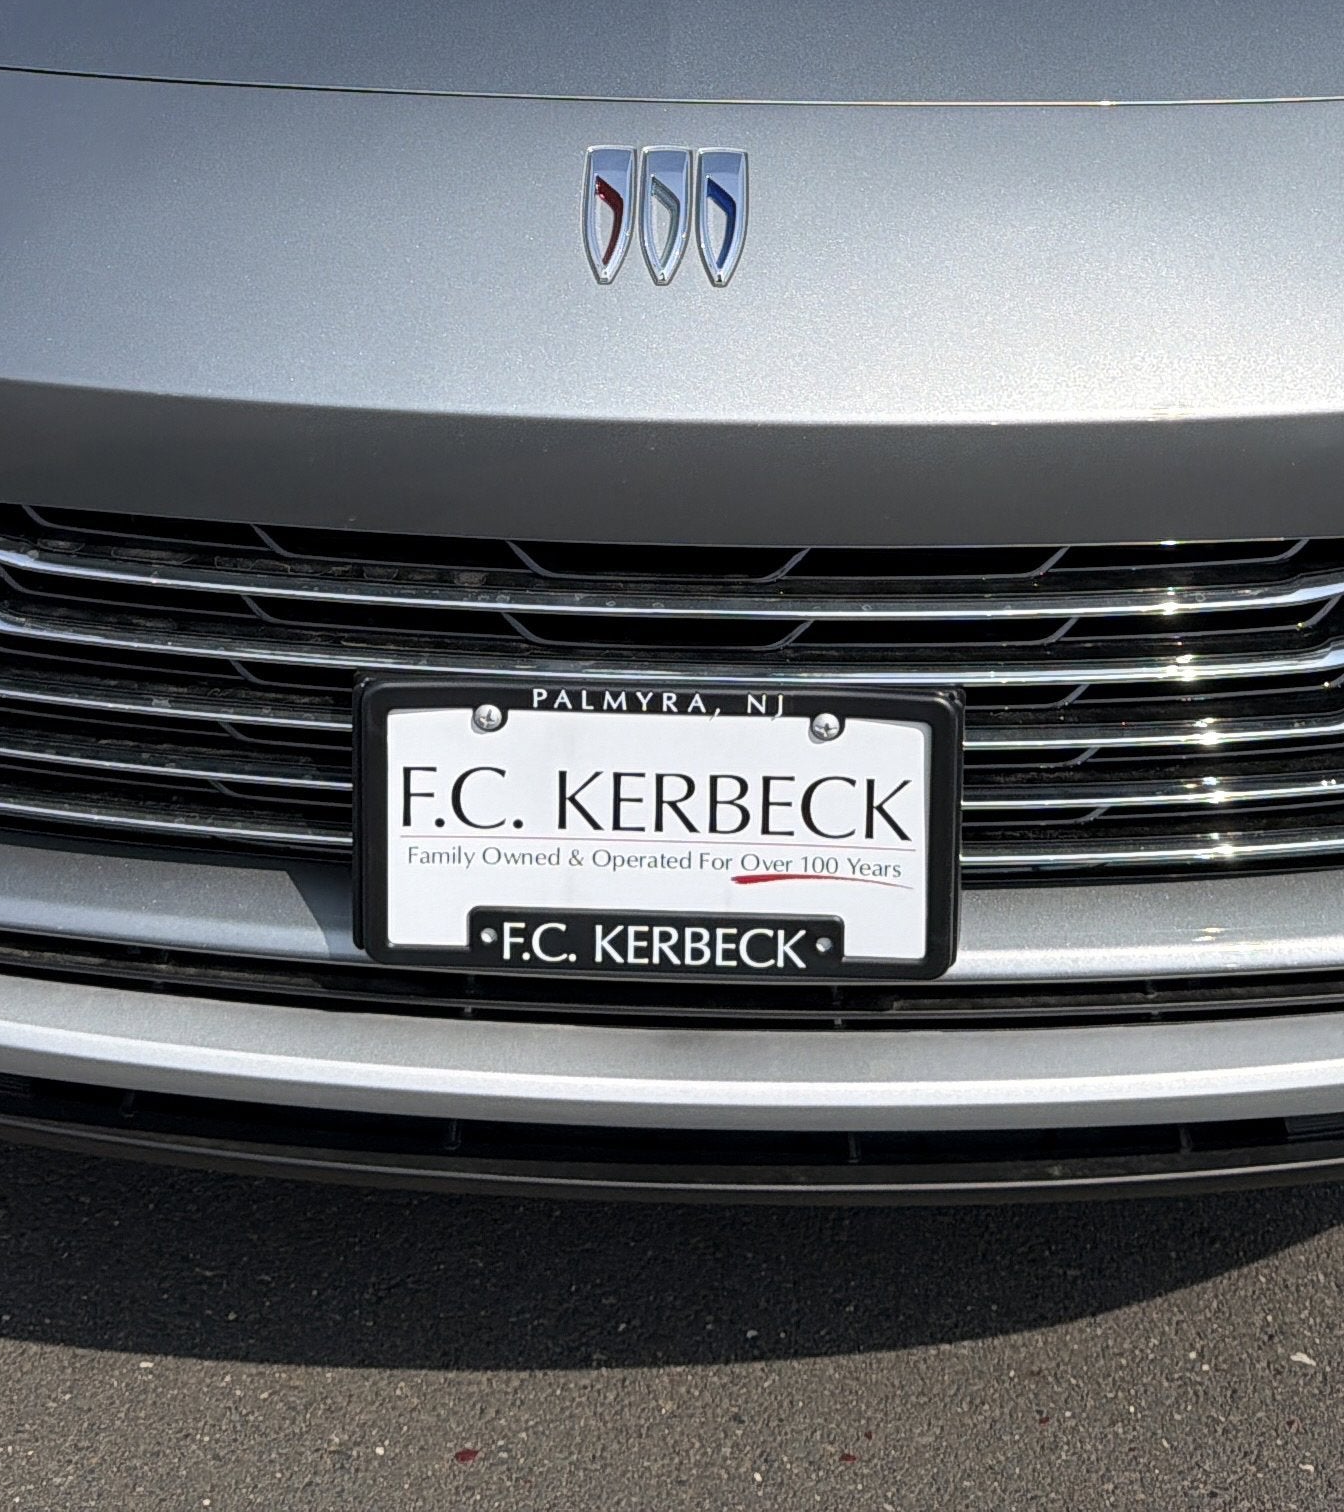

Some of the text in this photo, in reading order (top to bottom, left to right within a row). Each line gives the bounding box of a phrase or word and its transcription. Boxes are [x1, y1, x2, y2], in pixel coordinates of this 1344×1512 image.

[532, 688, 785, 720] PALMYRA, NJ
[402, 766, 913, 842] F.C. KERBECK
[407, 845, 903, 879] Family Owned & Operated For Over 100 Years
[502, 921, 807, 969] F.C. KERBECK
